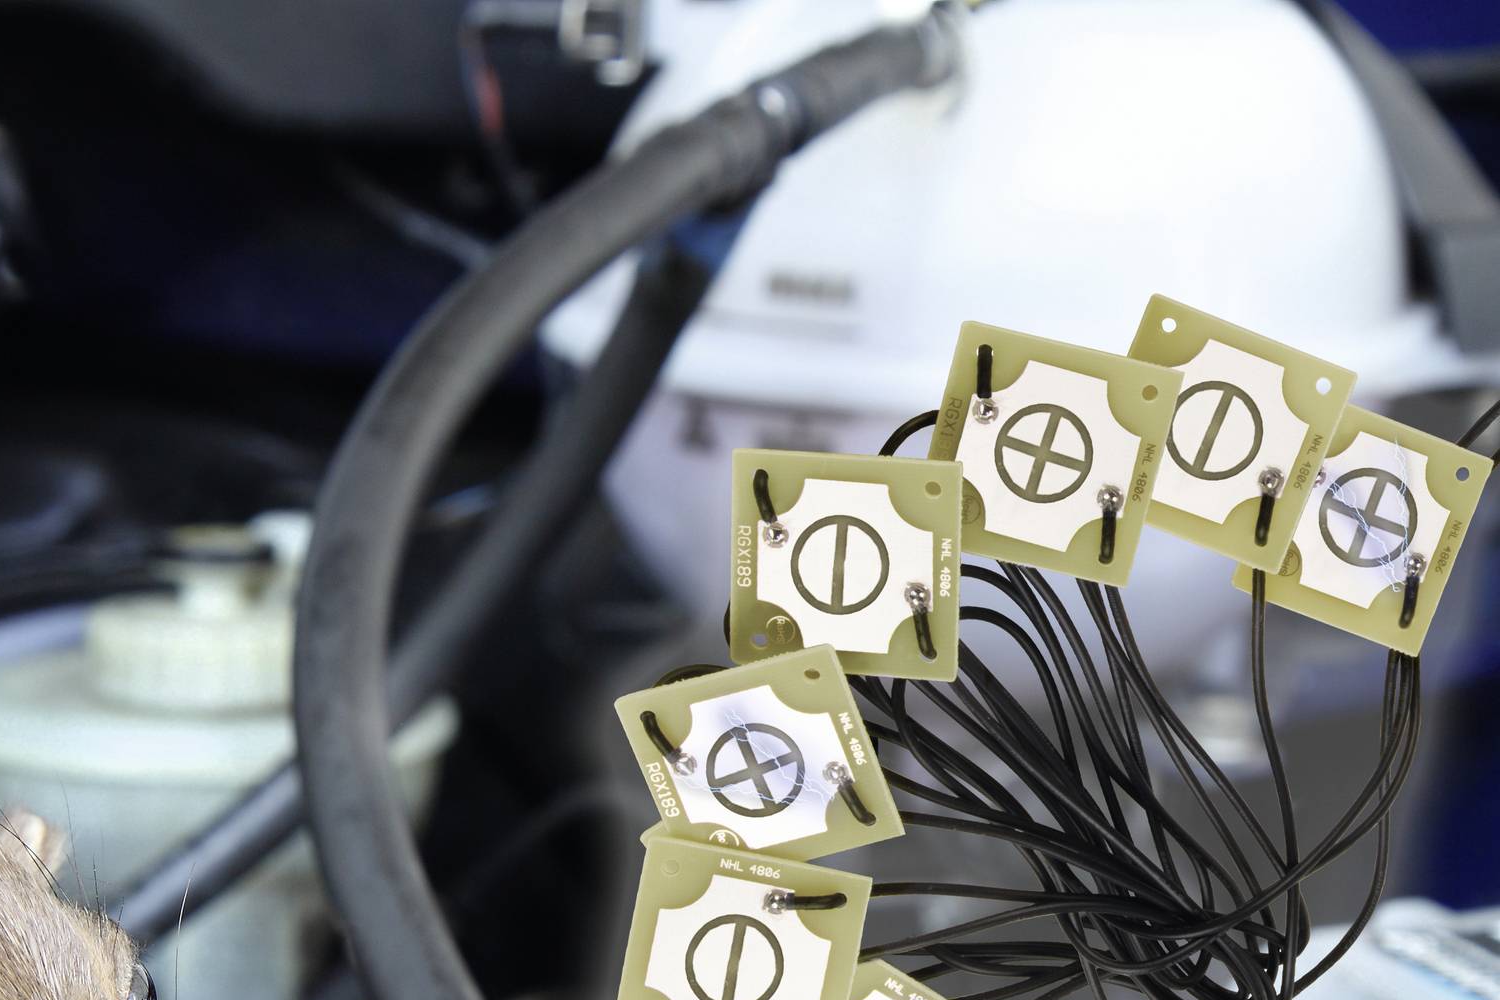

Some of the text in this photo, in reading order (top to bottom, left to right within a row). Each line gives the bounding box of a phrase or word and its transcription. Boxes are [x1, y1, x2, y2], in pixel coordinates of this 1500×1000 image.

[1306, 434, 1324, 455] NHL
[1131, 443, 1157, 503] NHL 4806
[736, 525, 752, 588] RGX189
[939, 537, 952, 598] NHL 4806
[838, 711, 868, 766] NHL 4806
[645, 762, 681, 818] RGX189
[719, 858, 781, 880] NHL 4806
[884, 976, 904, 997] NHL
